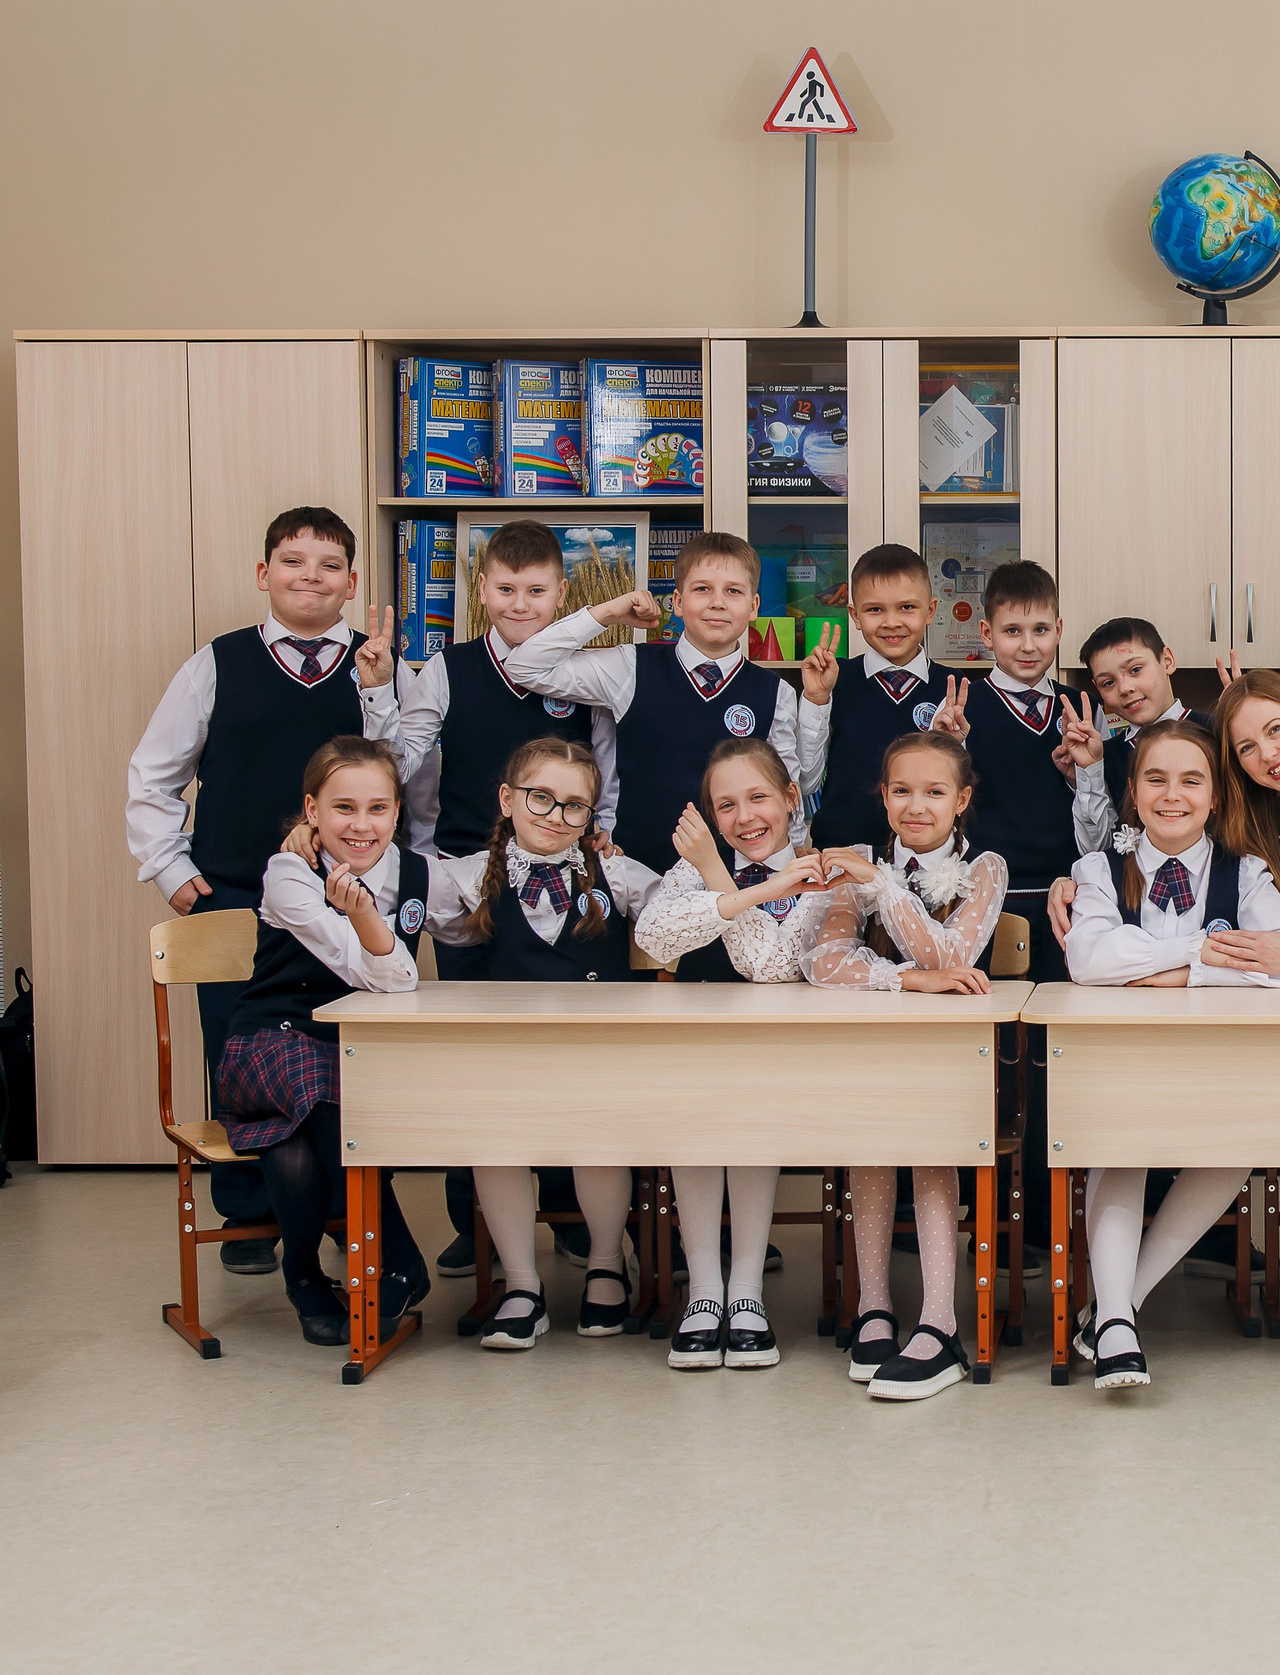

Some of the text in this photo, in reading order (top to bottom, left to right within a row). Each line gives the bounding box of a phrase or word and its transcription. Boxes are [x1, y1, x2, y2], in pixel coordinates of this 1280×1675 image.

[520, 370, 542, 378] ФГОС
[607, 369, 630, 377] ФГОС
[519, 380, 552, 390] спектр
[606, 378, 640, 389] спектр
[646, 388, 658, 396] ДЛЯ
[658, 388, 690, 396] НАЧАЛЬНОЙ
[604, 400, 702, 419] МАТЕМАТИК
[797, 400, 811, 413] 12
[430, 478, 443, 488] 24
[518, 479, 534, 489] 24
[605, 478, 619, 488] 24
[748, 477, 811, 487] ГИЯ ФИЗИКИ
[431, 560, 456, 578] МА
[429, 639, 443, 649] 24
[734, 713, 747, 727] 15
[773, 899, 787, 910] 15
[408, 910, 418, 923] 15
